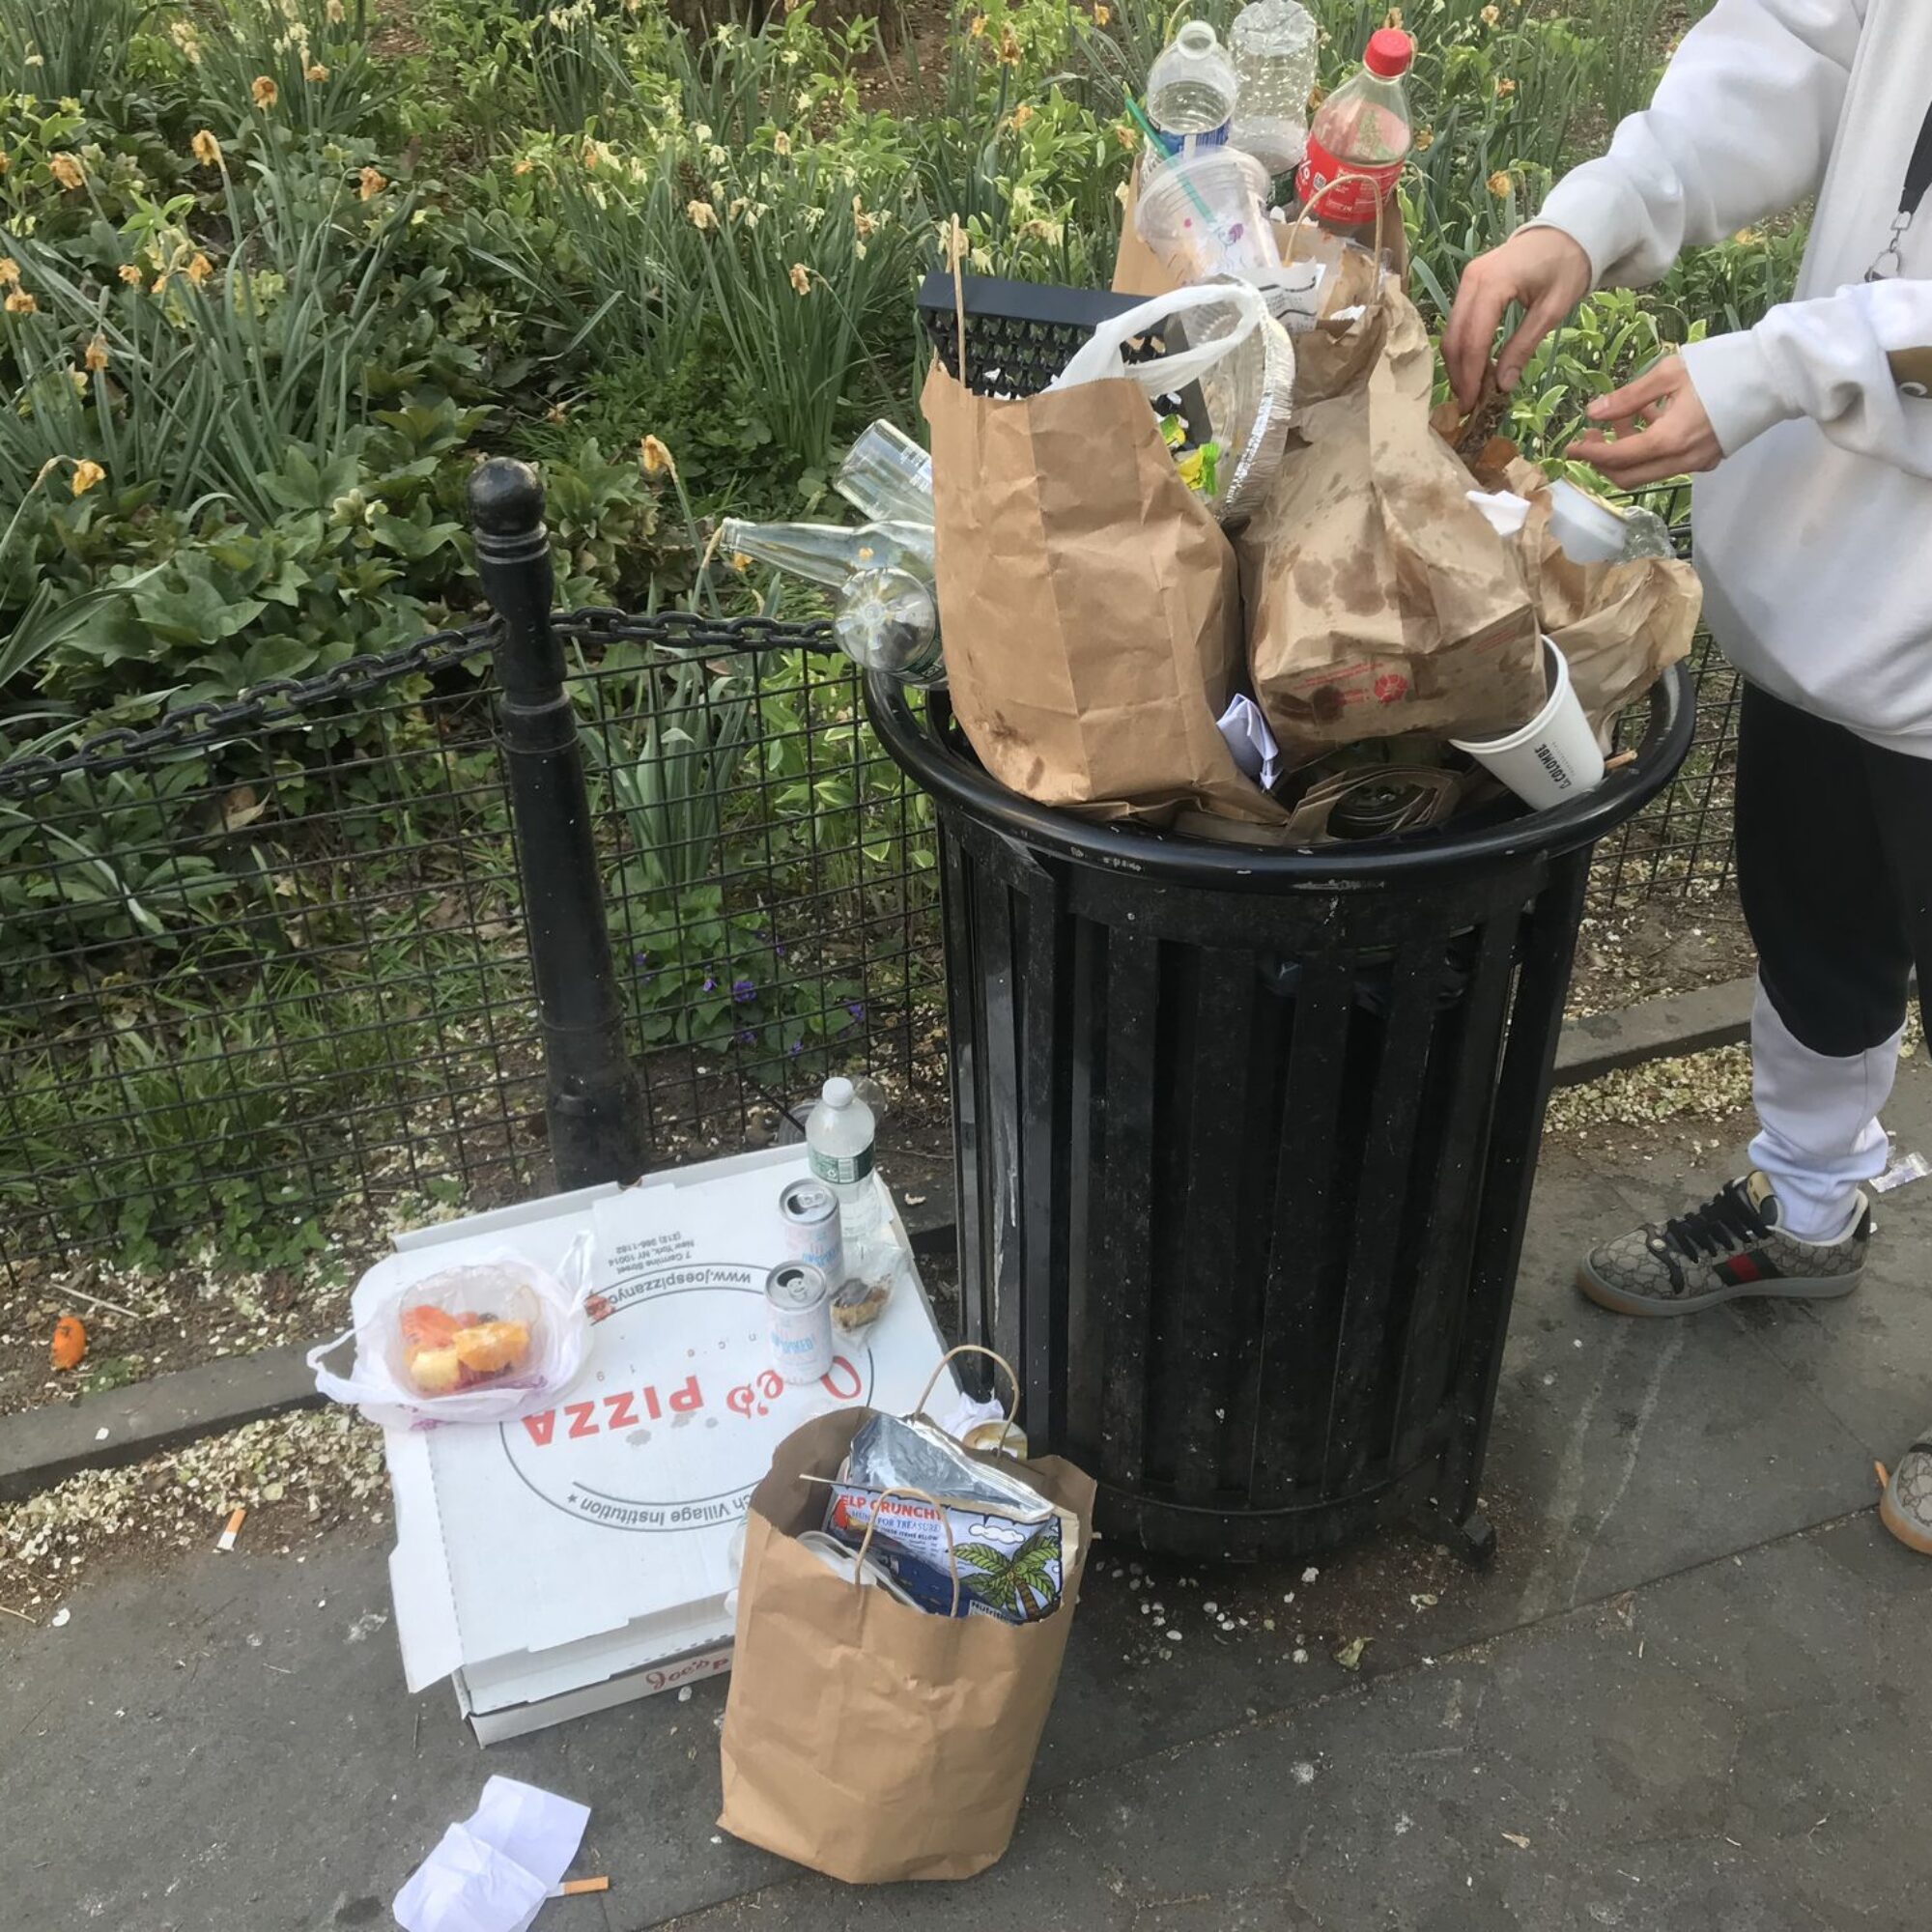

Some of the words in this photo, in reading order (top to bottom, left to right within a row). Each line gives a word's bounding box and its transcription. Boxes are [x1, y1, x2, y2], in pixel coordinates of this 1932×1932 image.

[1534, 744, 1566, 782] COLOMBE
[609, 1268, 752, 1304] www.joespizzanyc
[521, 1376, 705, 1447] PIZZA
[580, 1497, 665, 1526] Institution
[670, 1503, 730, 1522] Village
[840, 1494, 867, 1510] ELP
[851, 1510, 869, 1522] HUN
[877, 1517, 895, 1527] FOR
[645, 1660, 710, 1690] Joe's
